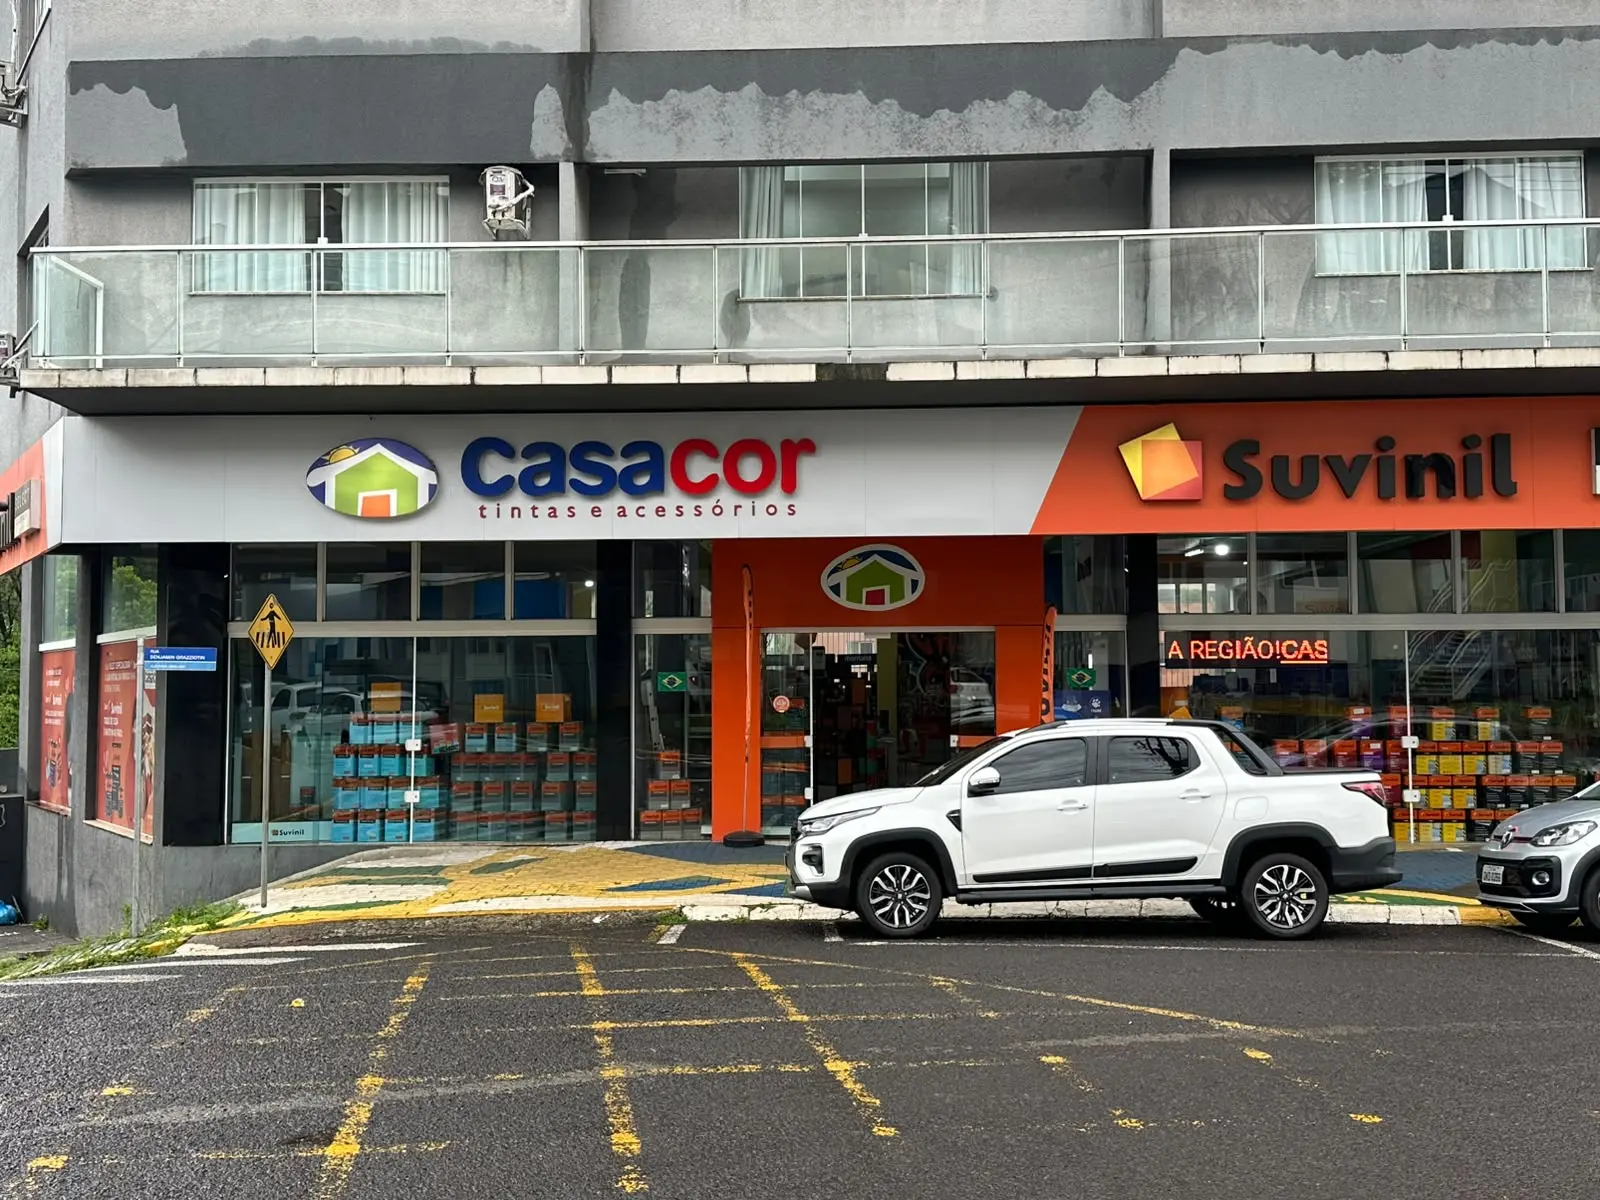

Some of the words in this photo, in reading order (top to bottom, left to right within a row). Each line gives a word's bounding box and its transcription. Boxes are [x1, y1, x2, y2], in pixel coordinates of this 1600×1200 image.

[460, 437, 816, 496] casacor
[1223, 433, 1518, 499] Suvinil
[478, 503, 576, 519] tintas
[590, 505, 602, 518] e
[617, 500, 796, 518] acessórios
[1168, 640, 1183, 659] A
